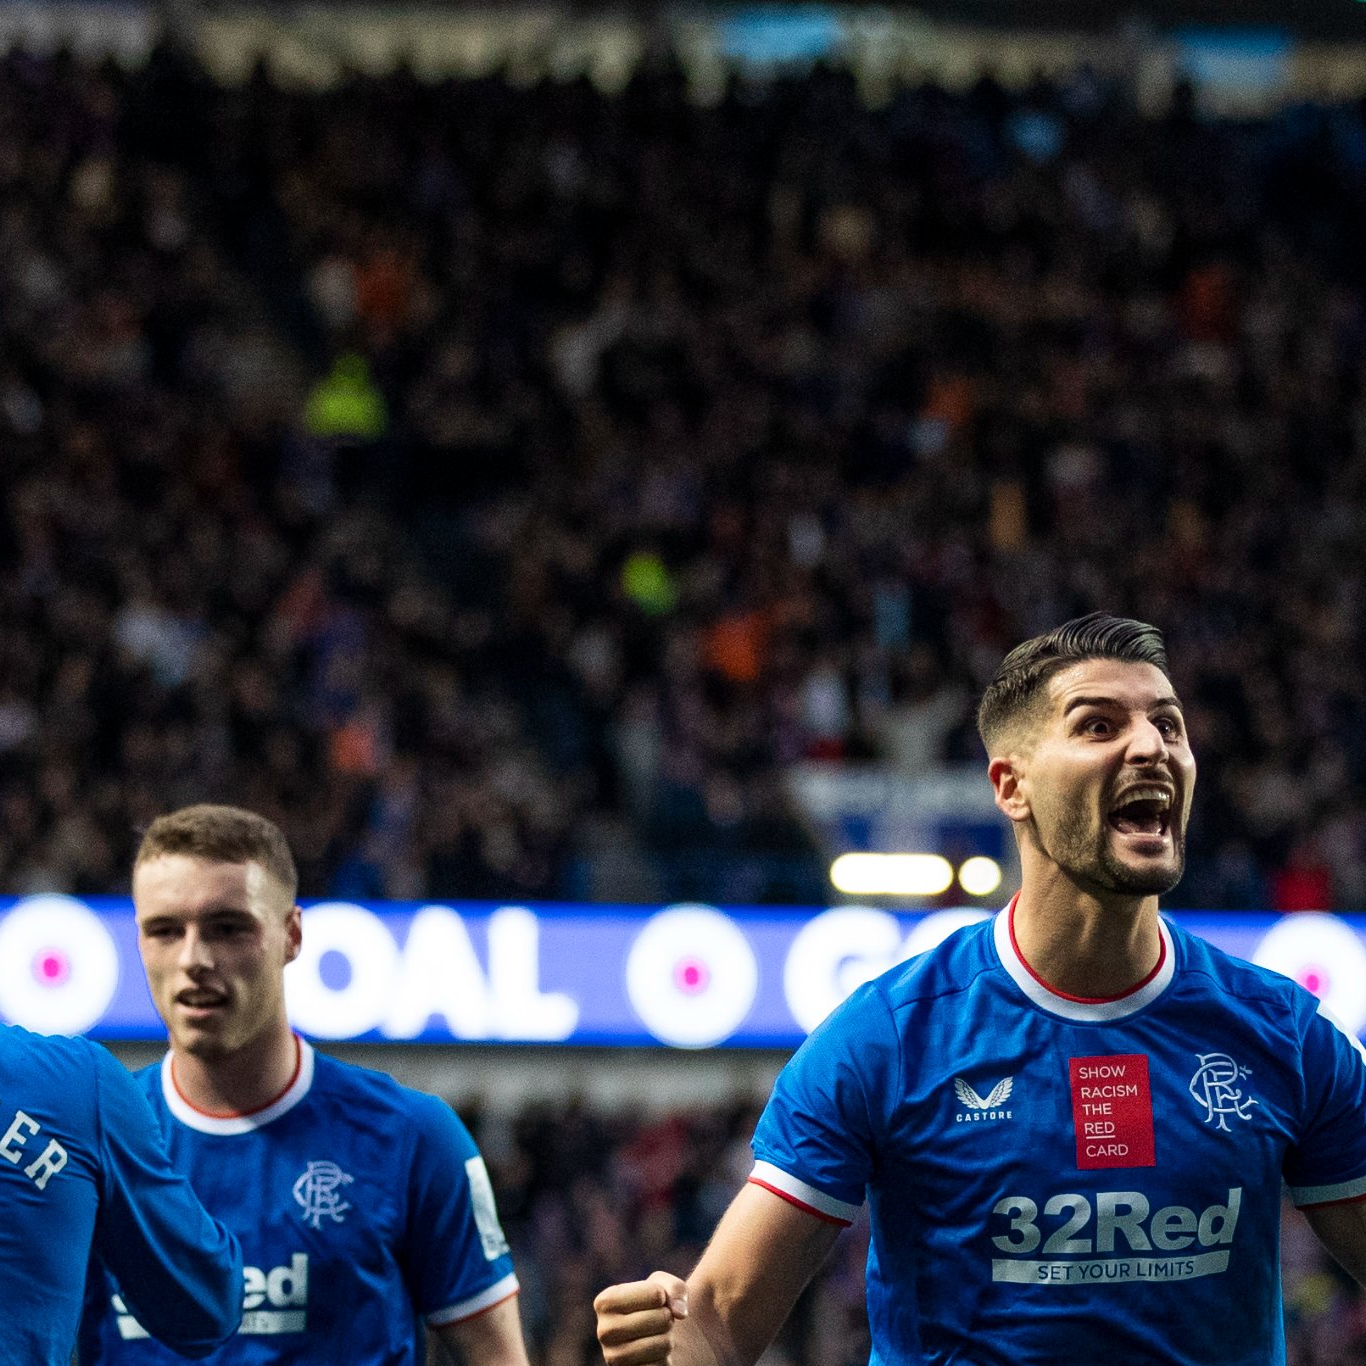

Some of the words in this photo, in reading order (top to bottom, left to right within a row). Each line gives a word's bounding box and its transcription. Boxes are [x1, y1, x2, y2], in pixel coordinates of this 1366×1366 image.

[284, 901, 580, 1042] OAL
[1078, 1064, 1127, 1080] SHOW
[1080, 1084, 1139, 1099] RACISM
[955, 1109, 1014, 1123] CASTORE
[1082, 1102, 1113, 1116] THE
[1084, 1121, 1116, 1136] RED
[1085, 1143, 1130, 1158] CARD
[991, 1187, 1243, 1254] 32Red
[1037, 1264, 1072, 1281] SET
[1077, 1262, 1133, 1280] YOUR
[1135, 1260, 1195, 1278] LIMITS
